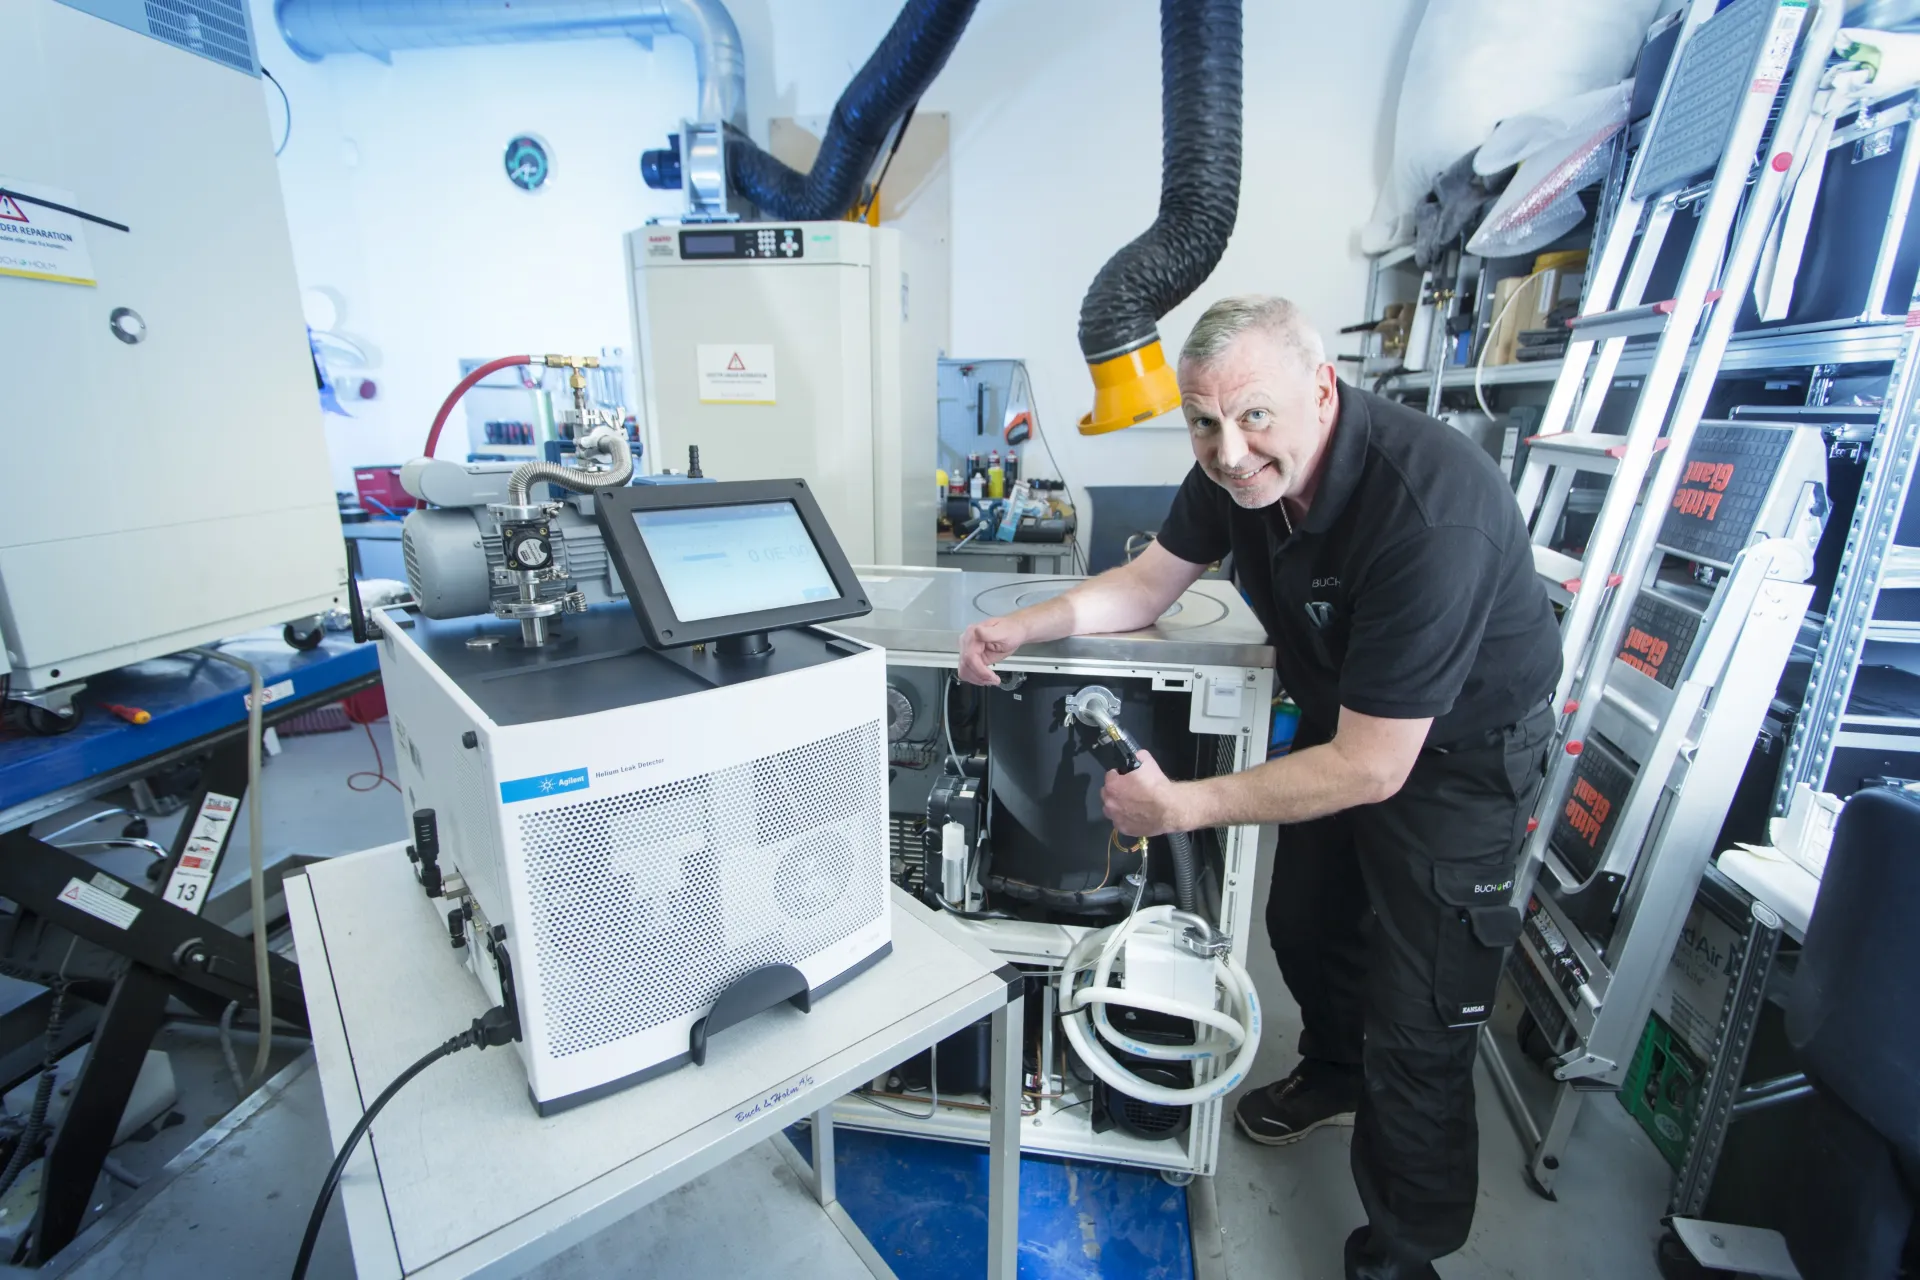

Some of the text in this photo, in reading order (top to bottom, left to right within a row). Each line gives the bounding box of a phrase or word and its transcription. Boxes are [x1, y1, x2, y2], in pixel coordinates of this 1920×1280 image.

[0, 222, 73, 242] DER REPARATION
[1682, 460, 1734, 492] Giant
[1672, 488, 1723, 521] Little
[1624, 626, 1669, 667] Giant
[558, 775, 585, 787] Agilent
[595, 757, 665, 779] Helium Leak Detector
[1573, 775, 1611, 824] Giant
[1565, 798, 1601, 848] Little
[176, 882, 198, 902] 13
[1474, 880, 1513, 893] BUCH HO
[1696, 935, 1724, 968] Air
[1462, 1005, 1485, 1014] KANSAS
[735, 1104, 761, 1122] Buch
[770, 1087, 799, 1104] Holm
